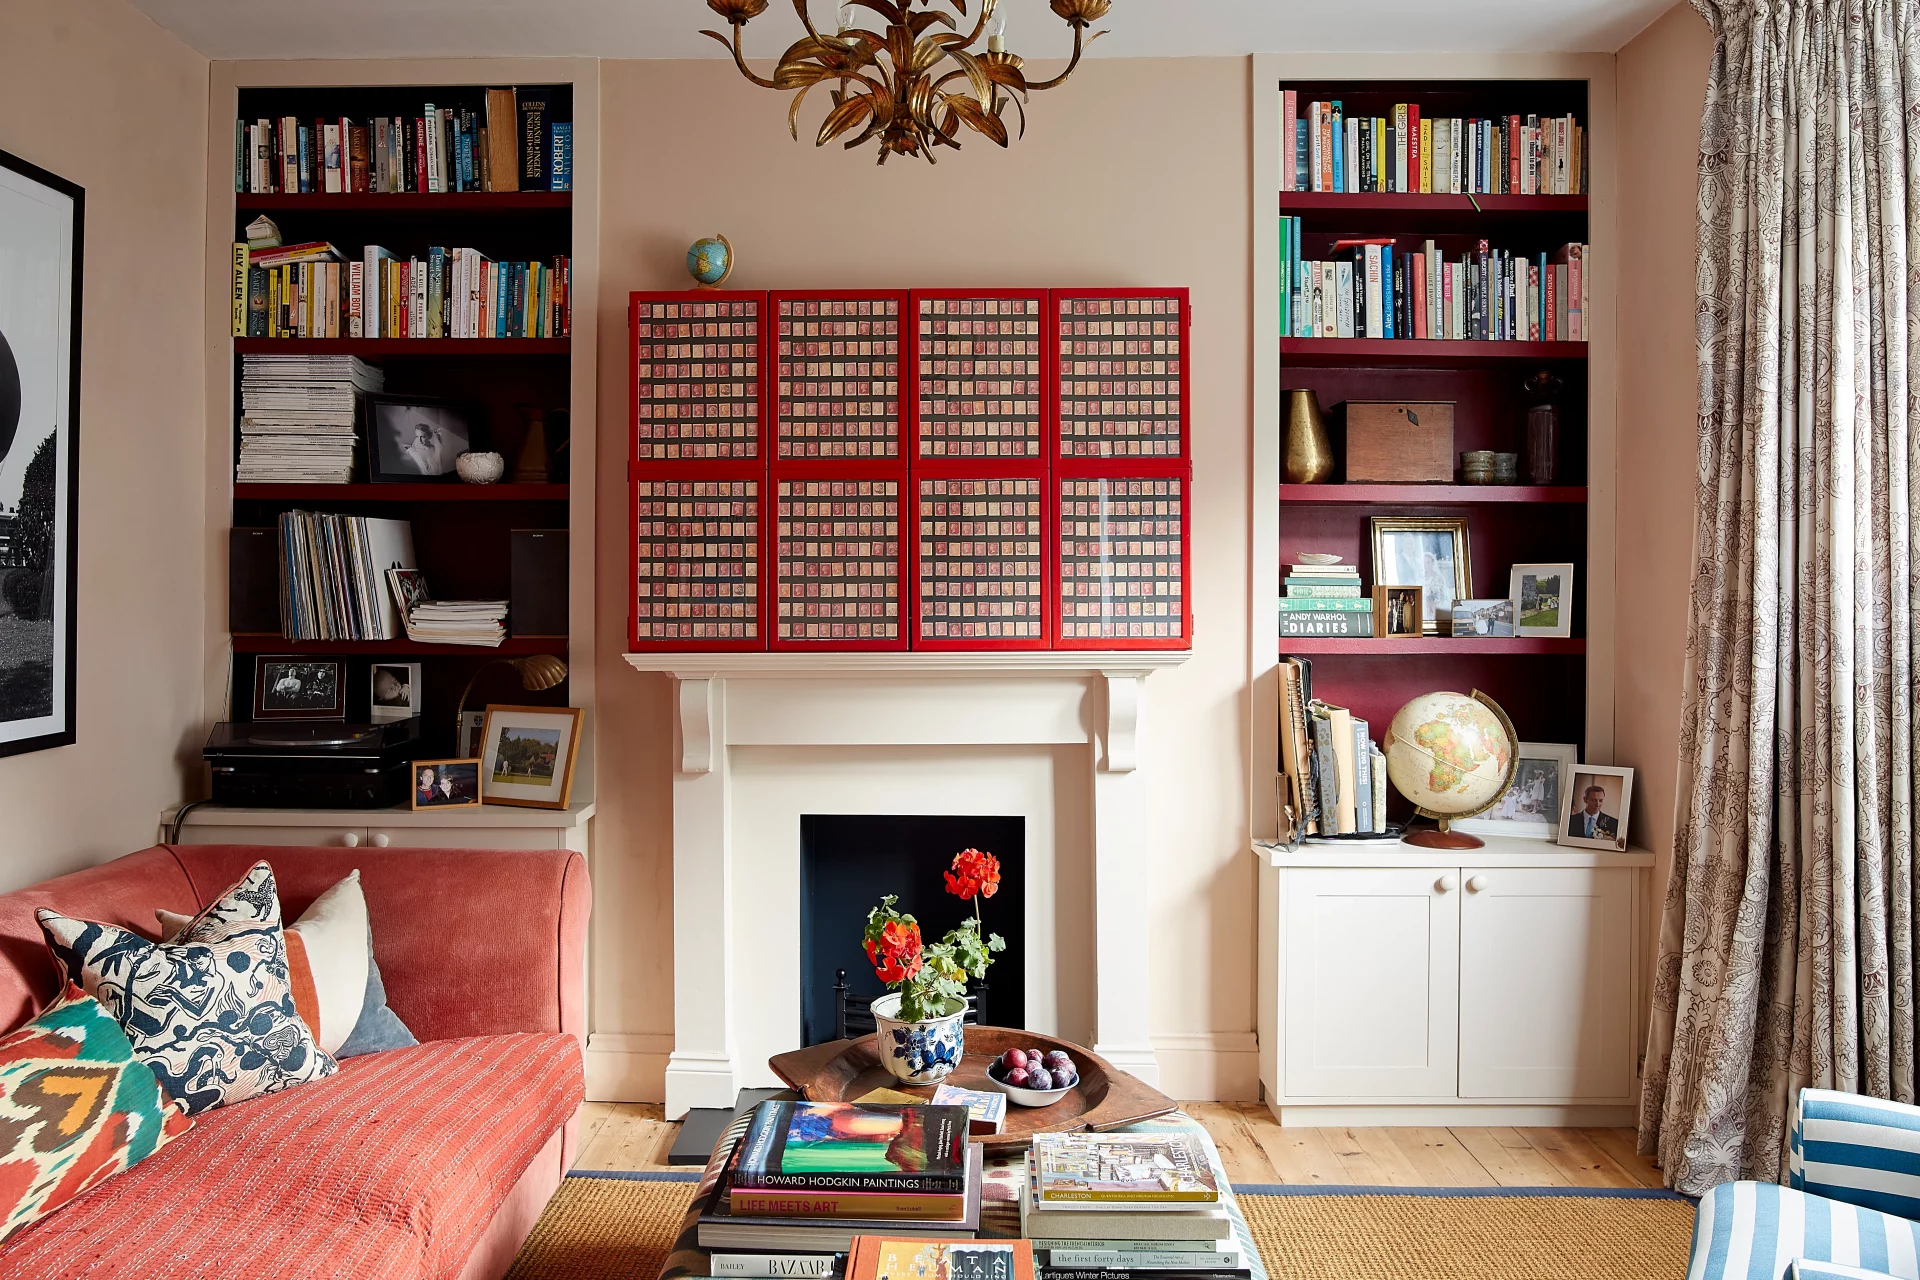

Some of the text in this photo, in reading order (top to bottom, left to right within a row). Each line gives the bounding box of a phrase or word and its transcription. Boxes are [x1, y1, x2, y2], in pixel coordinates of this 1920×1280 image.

[1398, 105, 1406, 146] THE GIRLS
[534, 111, 542, 178] ESPAÑOL INGLÉS
[552, 134, 564, 189] LE ROBERT
[1370, 255, 1378, 283] SACHIN
[253, 271, 261, 299] MARTIN
[352, 264, 360, 316] WILLIAM BOYD
[1289, 622, 1348, 633] DIARIES
[757, 1175, 806, 1186] HOWARD
[808, 1176, 860, 1187] HODGKIN
[864, 1178, 920, 1188] PAINTINGS
[740, 1199, 839, 1212] LIFE MEETS ART
[887, 1254, 1006, 1265] BEATA
[1094, 1255, 1114, 1265] forty
[1116, 1255, 1134, 1265] days
[769, 1260, 824, 1275] BAZAAR
[886, 1262, 1007, 1274] HEUMAN
[1040, 1272, 1074, 1280] Lartigue's
